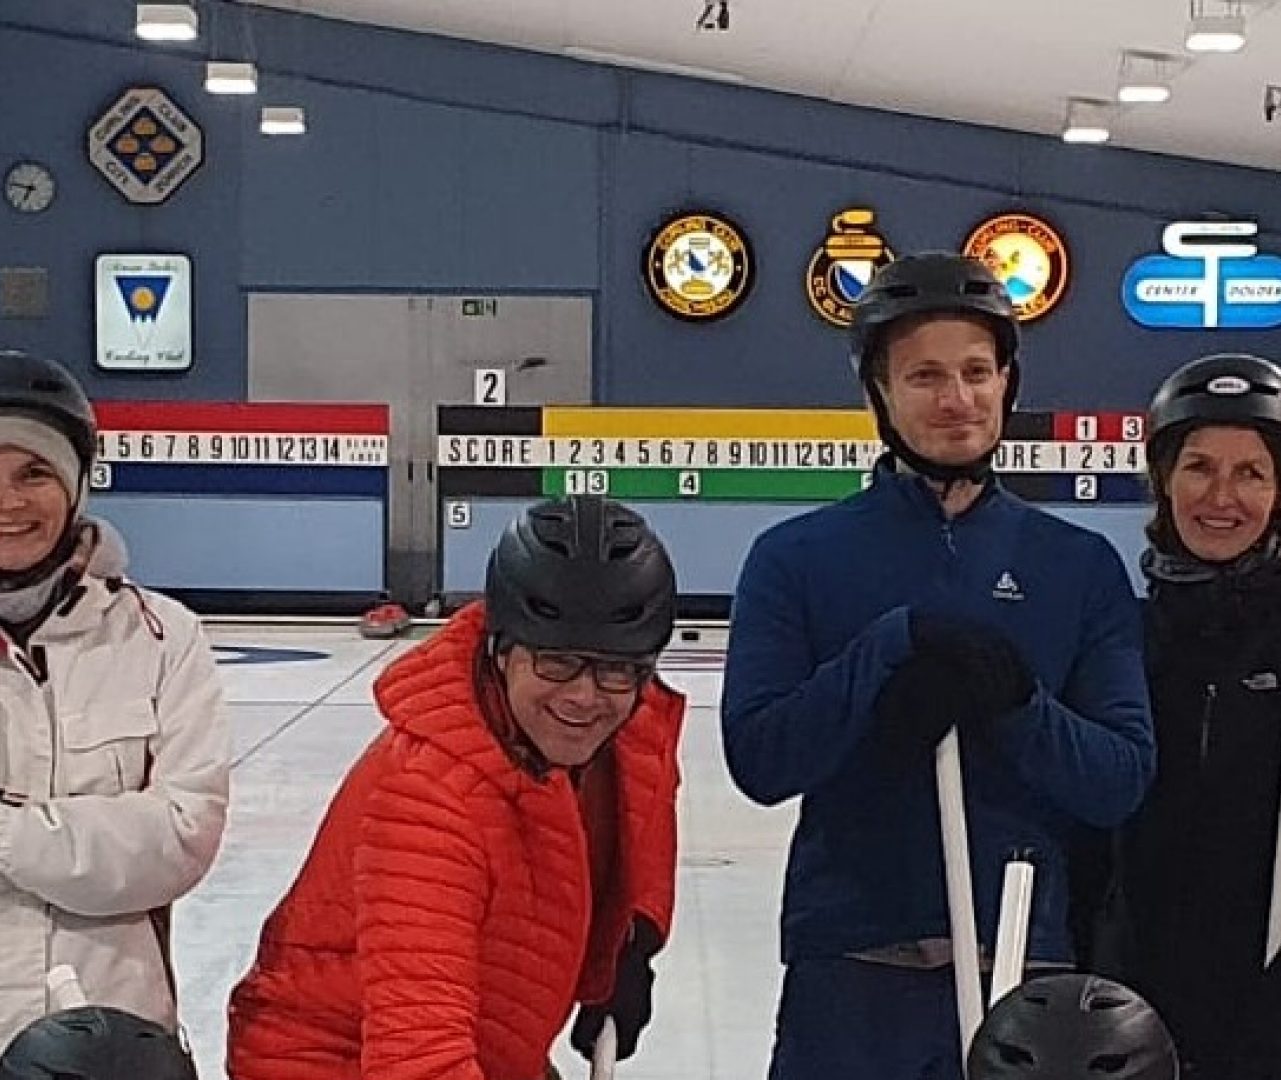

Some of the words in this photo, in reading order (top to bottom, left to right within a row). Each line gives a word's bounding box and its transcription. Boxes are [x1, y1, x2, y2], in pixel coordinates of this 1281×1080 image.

[483, 373, 498, 402] 2
[1126, 418, 1139, 438] 3
[119, 434, 131, 458] 5
[141, 434, 154, 458] 6
[165, 434, 176, 458] 7
[188, 434, 199, 459] 8
[210, 435, 222, 459] 9
[230, 436, 250, 460] 10
[254, 436, 270, 460] 11
[277, 436, 295, 461] 12
[299, 436, 317, 461] 13
[322, 437, 339, 462] 14
[448, 438, 532, 464] SCORE
[548, 439, 555, 463] 1
[570, 439, 581, 464] 2
[592, 439, 605, 464] 3
[615, 440, 626, 464] 4
[638, 440, 650, 464] 5
[660, 440, 673, 465] 6
[683, 441, 695, 465] 7
[707, 441, 718, 465] 8
[729, 442, 741, 466] 9
[749, 442, 767, 467] 10
[773, 442, 789, 467] 11
[795, 442, 812, 467] 12
[817, 442, 835, 467] 13
[840, 442, 858, 467] 14
[995, 444, 1041, 469] ORE
[1060, 445, 1066, 469] 1
[1082, 445, 1093, 469] 2
[1103, 445, 1115, 469] 3
[1126, 446, 1138, 469] 4
[93, 467, 108, 486] 3
[568, 473, 578, 492] 1
[591, 472, 605, 492] 3
[683, 474, 695, 491] 4
[1079, 478, 1092, 498] 2
[452, 505, 466, 523] 5
